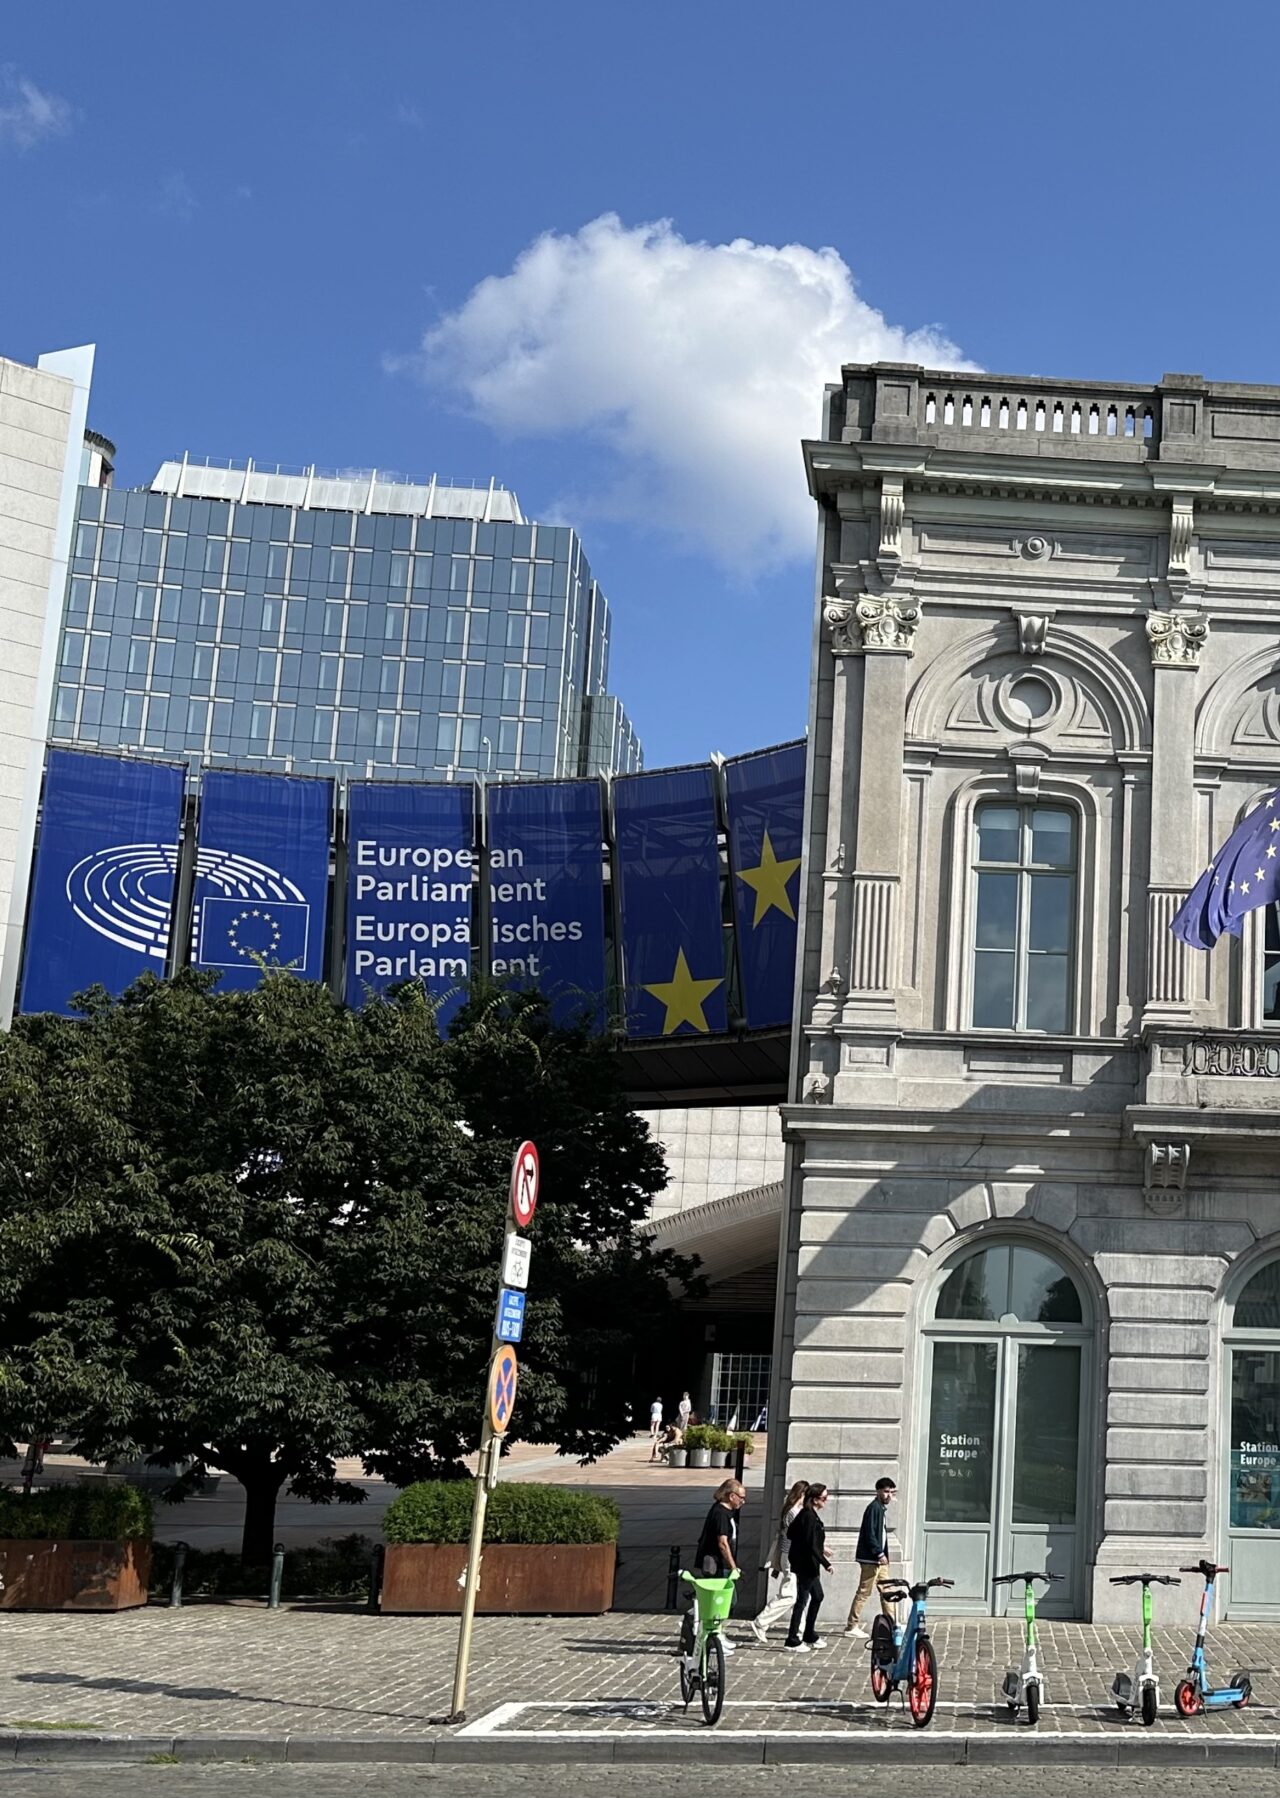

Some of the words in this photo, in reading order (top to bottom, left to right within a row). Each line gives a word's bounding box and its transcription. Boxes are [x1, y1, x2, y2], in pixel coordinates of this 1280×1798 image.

[357, 840, 524, 872] European
[356, 874, 547, 902] Parliament
[355, 915, 583, 948] Europäisches
[355, 949, 540, 977] Parlament
[940, 1433, 980, 1445] Station
[1240, 1441, 1279, 1453] Station
[940, 1447, 978, 1461] Europe
[1240, 1454, 1277, 1467] Europe
